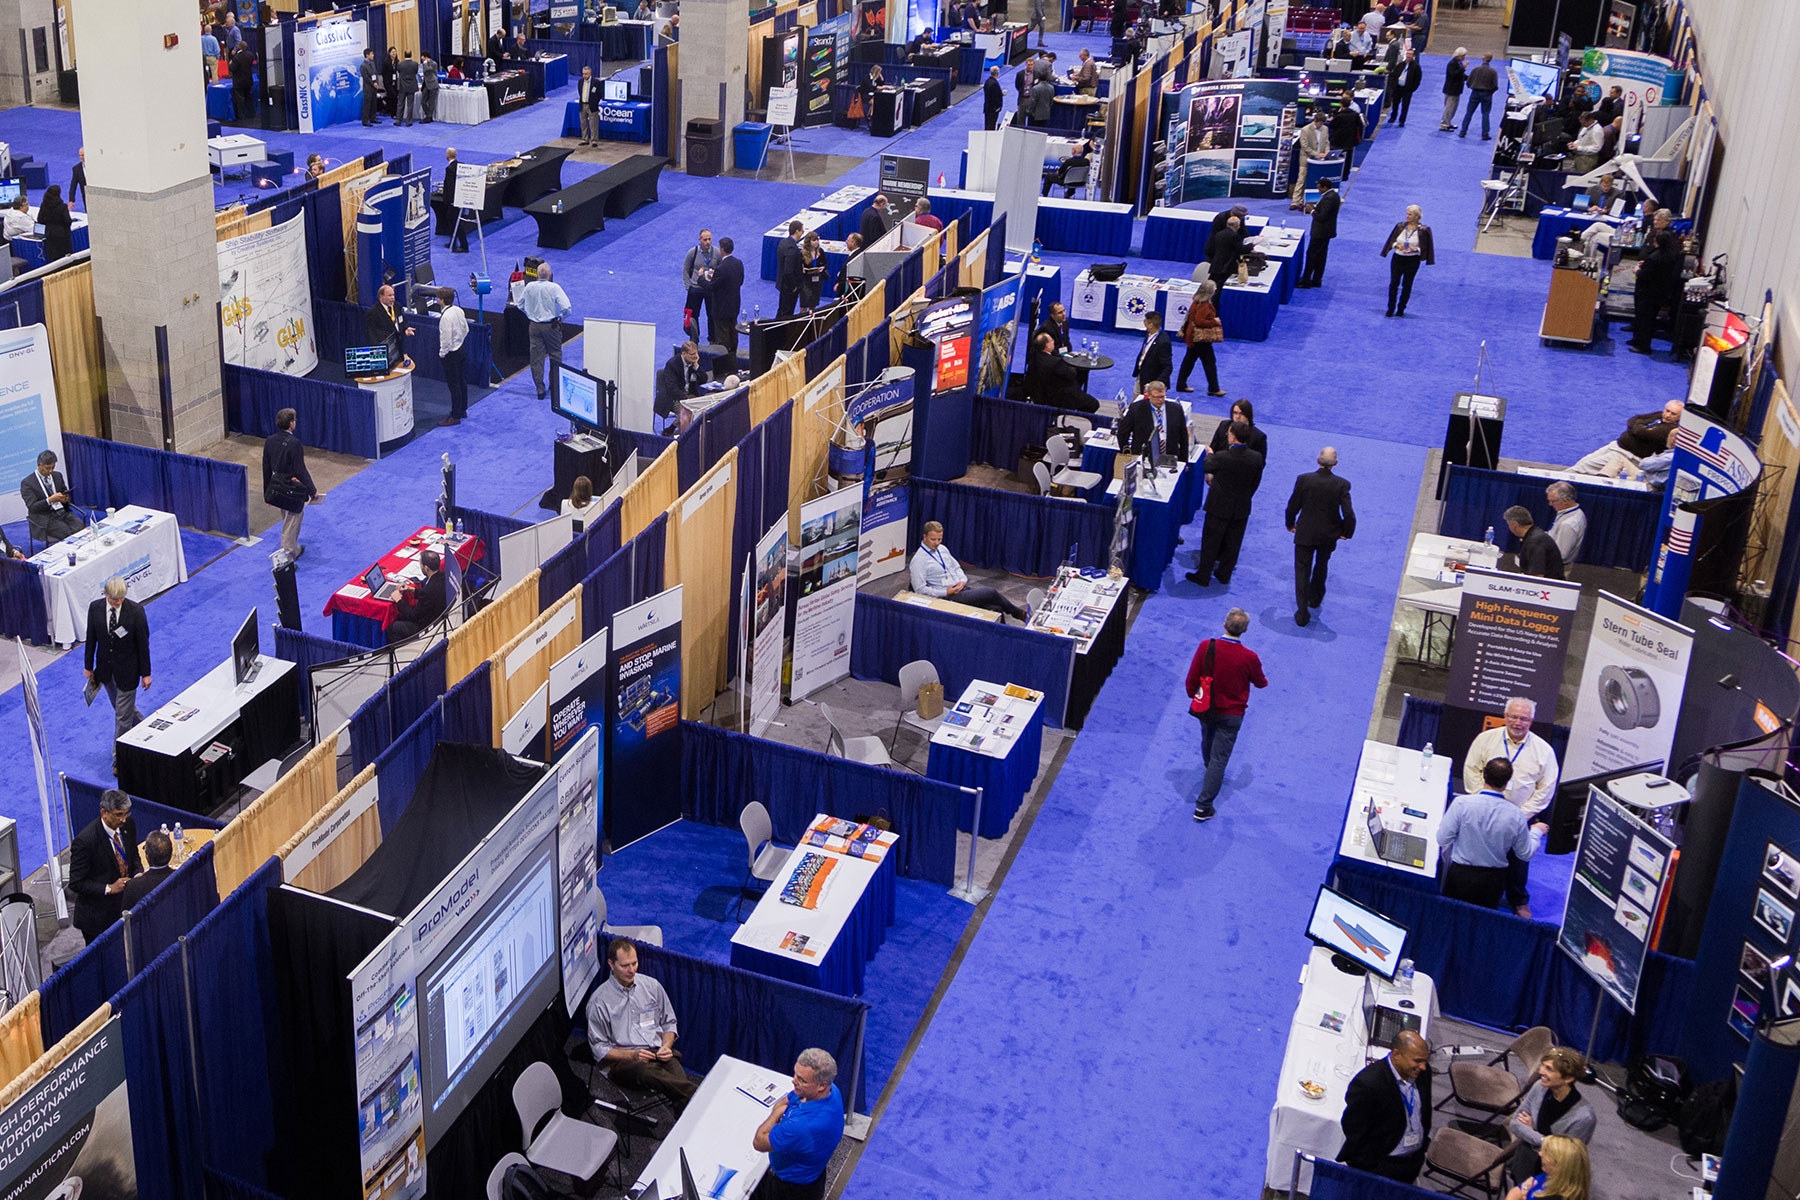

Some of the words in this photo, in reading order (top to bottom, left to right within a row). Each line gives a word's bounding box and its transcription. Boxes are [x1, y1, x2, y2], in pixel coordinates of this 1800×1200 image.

[299, 85, 309, 119] ClassNK
[603, 106, 633, 118] Ocean
[603, 116, 633, 124] Engineering
[222, 296, 252, 327] GHS
[277, 317, 305, 348] GLM
[853, 388, 899, 418] COOPERATION
[1470, 611, 1493, 622] Mini
[1496, 614, 1520, 626] Data
[1522, 619, 1560, 634] Logger
[1475, 601, 1501, 613] High
[1503, 604, 1559, 623] Frequency
[1467, 628, 1490, 637] Accurate
[1490, 631, 1503, 639] Data
[1503, 634, 1531, 644] Recording
[1602, 617, 1628, 637] Stern
[1631, 630, 1654, 649] Tube
[1656, 642, 1679, 661] Seal
[619, 662, 633, 673] AND
[634, 652, 652, 666] STOP
[652, 640, 677, 657] MARINE
[619, 659, 654, 681] INVASIONS
[552, 696, 581, 723] OPERATE
[552, 700, 586, 732] WHEREVER
[552, 726, 567, 740] YOU
[567, 711, 584, 728] WANT
[418, 867, 480, 942] ProModel
[20, 1036, 109, 1119] PERFORMANCE
